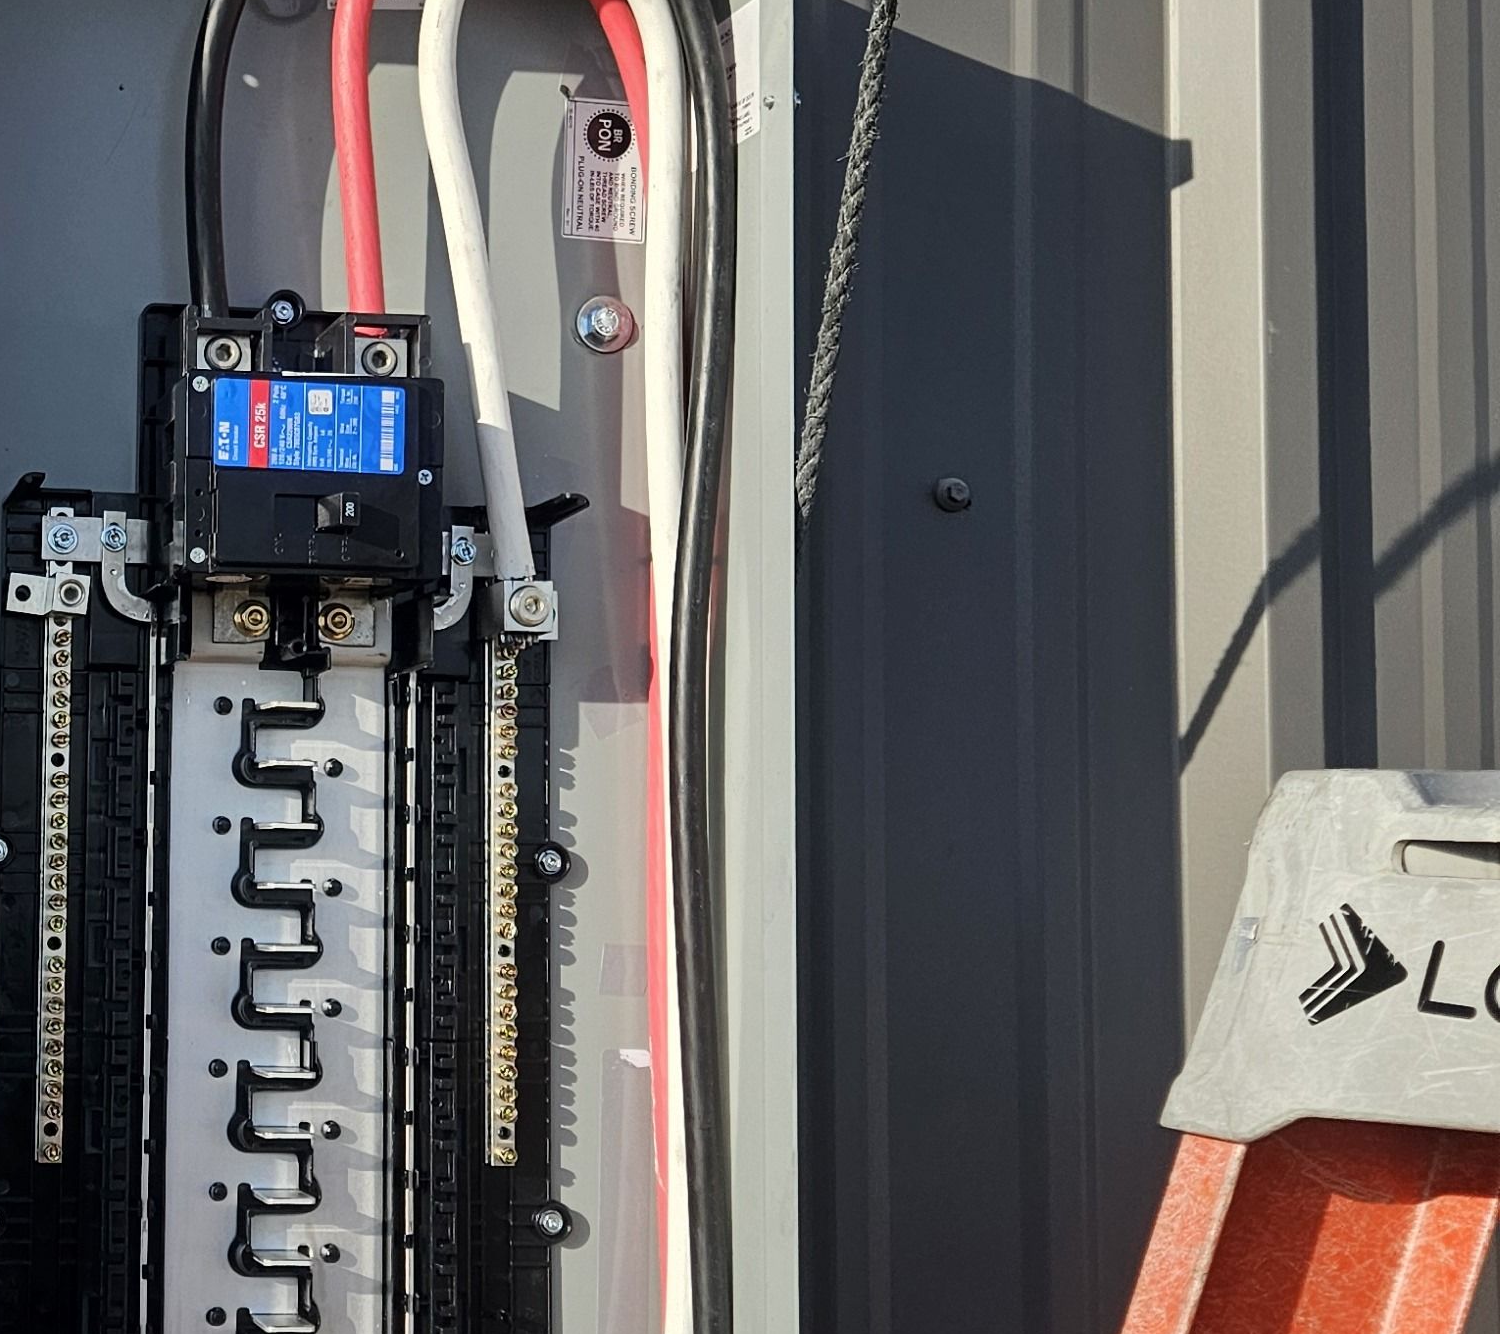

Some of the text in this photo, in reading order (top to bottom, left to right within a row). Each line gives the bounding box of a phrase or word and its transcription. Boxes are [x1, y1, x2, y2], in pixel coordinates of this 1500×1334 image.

[598, 119, 612, 151] PON
[613, 129, 623, 143] BR
[576, 156, 585, 232] PLUG-ON NEUTRAL
[254, 425, 265, 448] CSR
[345, 502, 354, 517] 200
[1417, 940, 1500, 1024] L
